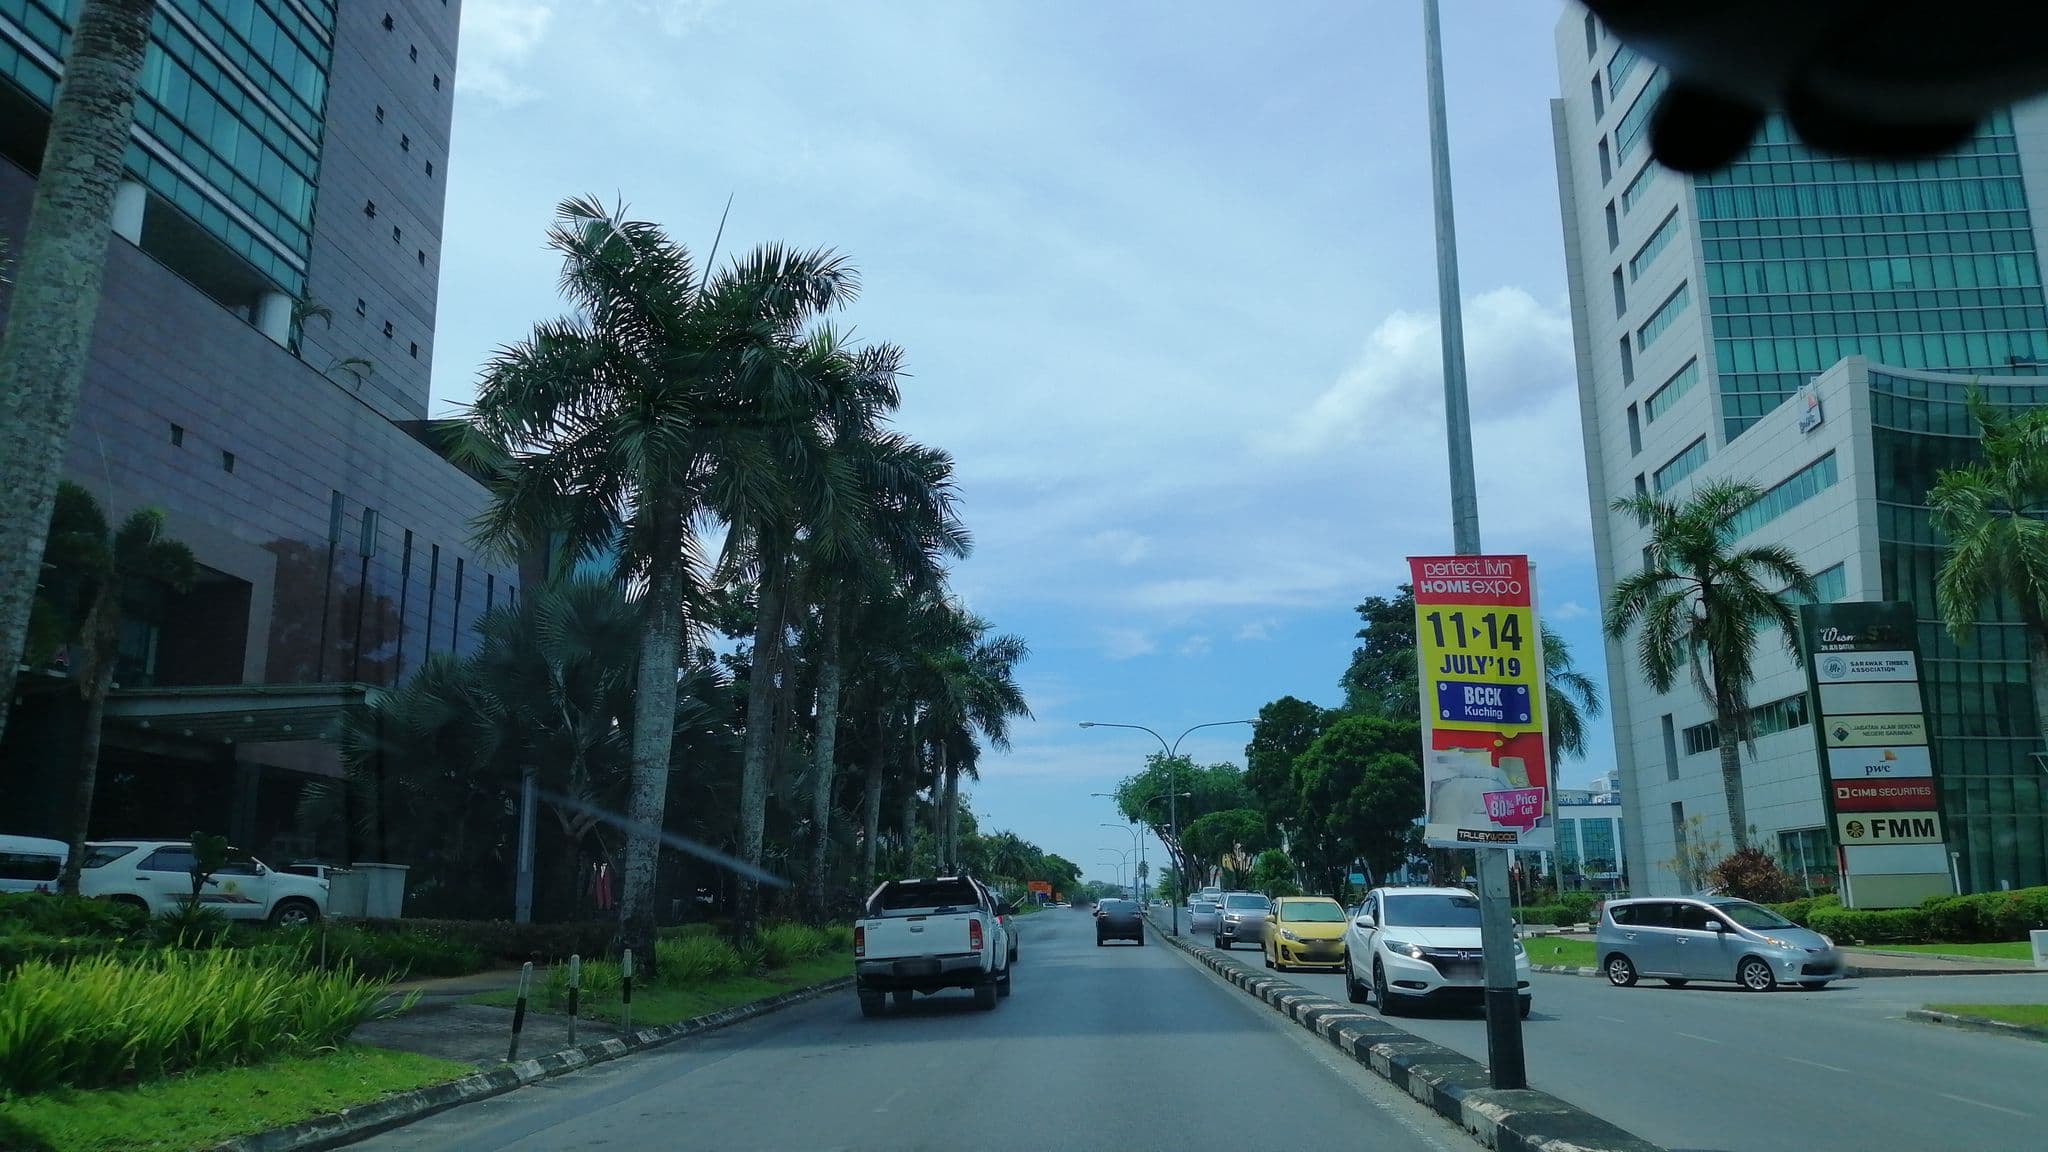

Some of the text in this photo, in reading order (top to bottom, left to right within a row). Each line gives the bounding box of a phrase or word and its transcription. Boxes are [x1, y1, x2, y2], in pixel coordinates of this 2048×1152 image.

[1424, 561, 1481, 577] perfect
[1427, 612, 1522, 650] 11 14
[1440, 655, 1520, 677] JULY'19
[1463, 686, 1503, 706] BCCK
[1464, 705, 1504, 720] Kuching
[1864, 765, 1891, 776] pwc
[1515, 793, 1538, 806] Price
[1851, 787, 1932, 797] CIMB SECURITIES
[1521, 805, 1533, 815] Cut
[1871, 819, 1935, 838] FMM
